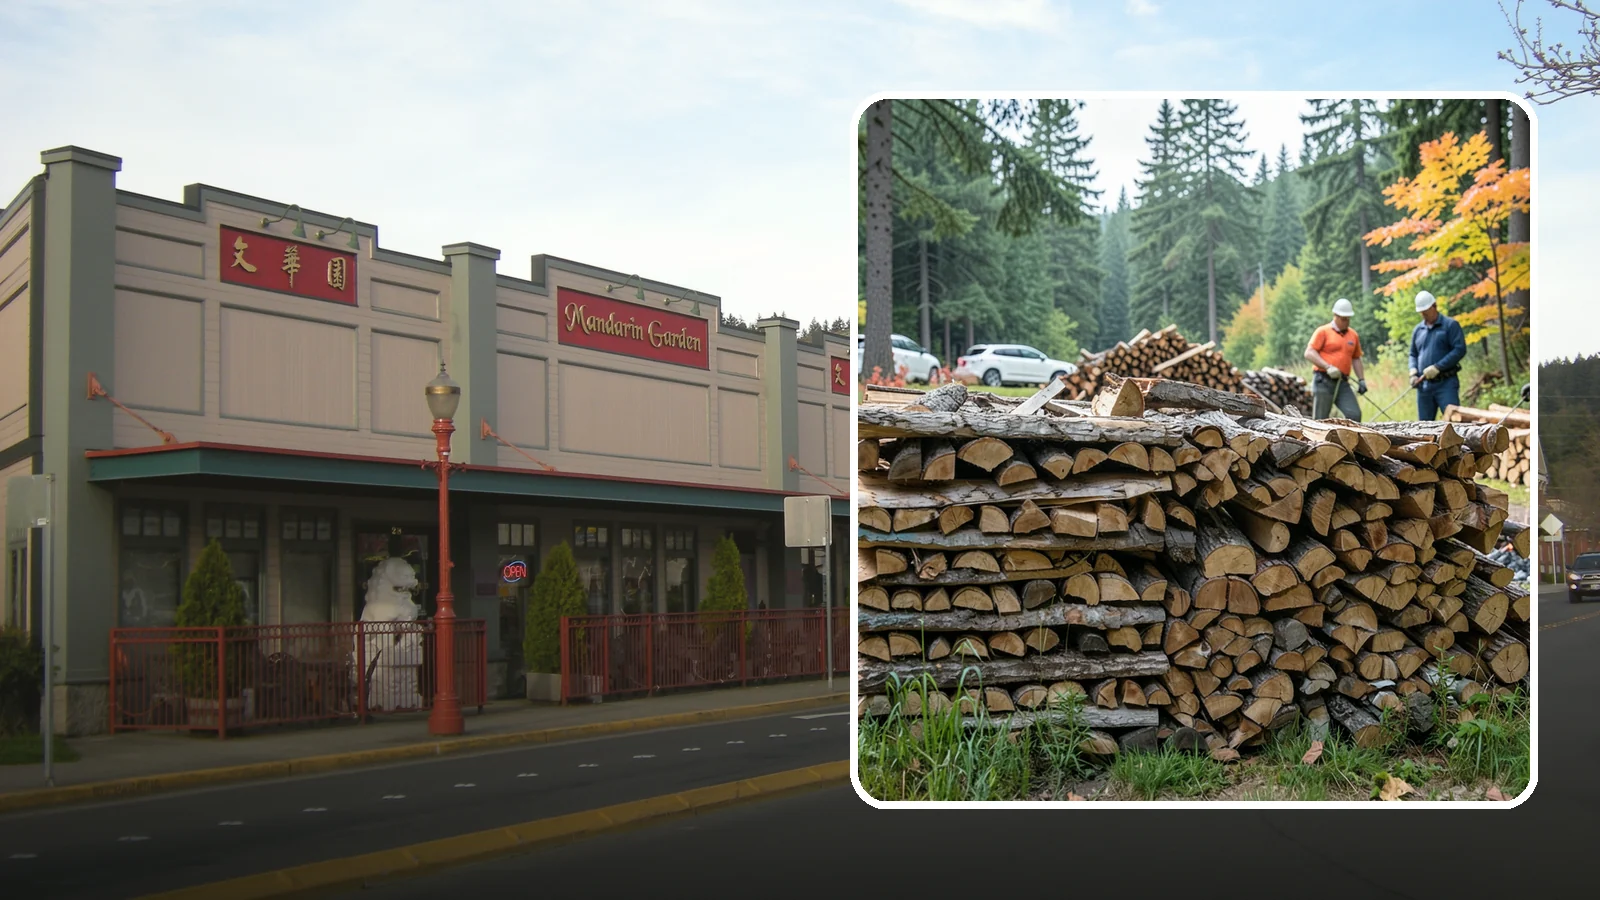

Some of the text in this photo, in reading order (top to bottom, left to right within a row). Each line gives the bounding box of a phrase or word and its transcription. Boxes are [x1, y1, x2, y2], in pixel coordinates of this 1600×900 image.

[564, 302, 701, 352] Mandarin Garden
[503, 565, 527, 578] OPEN
